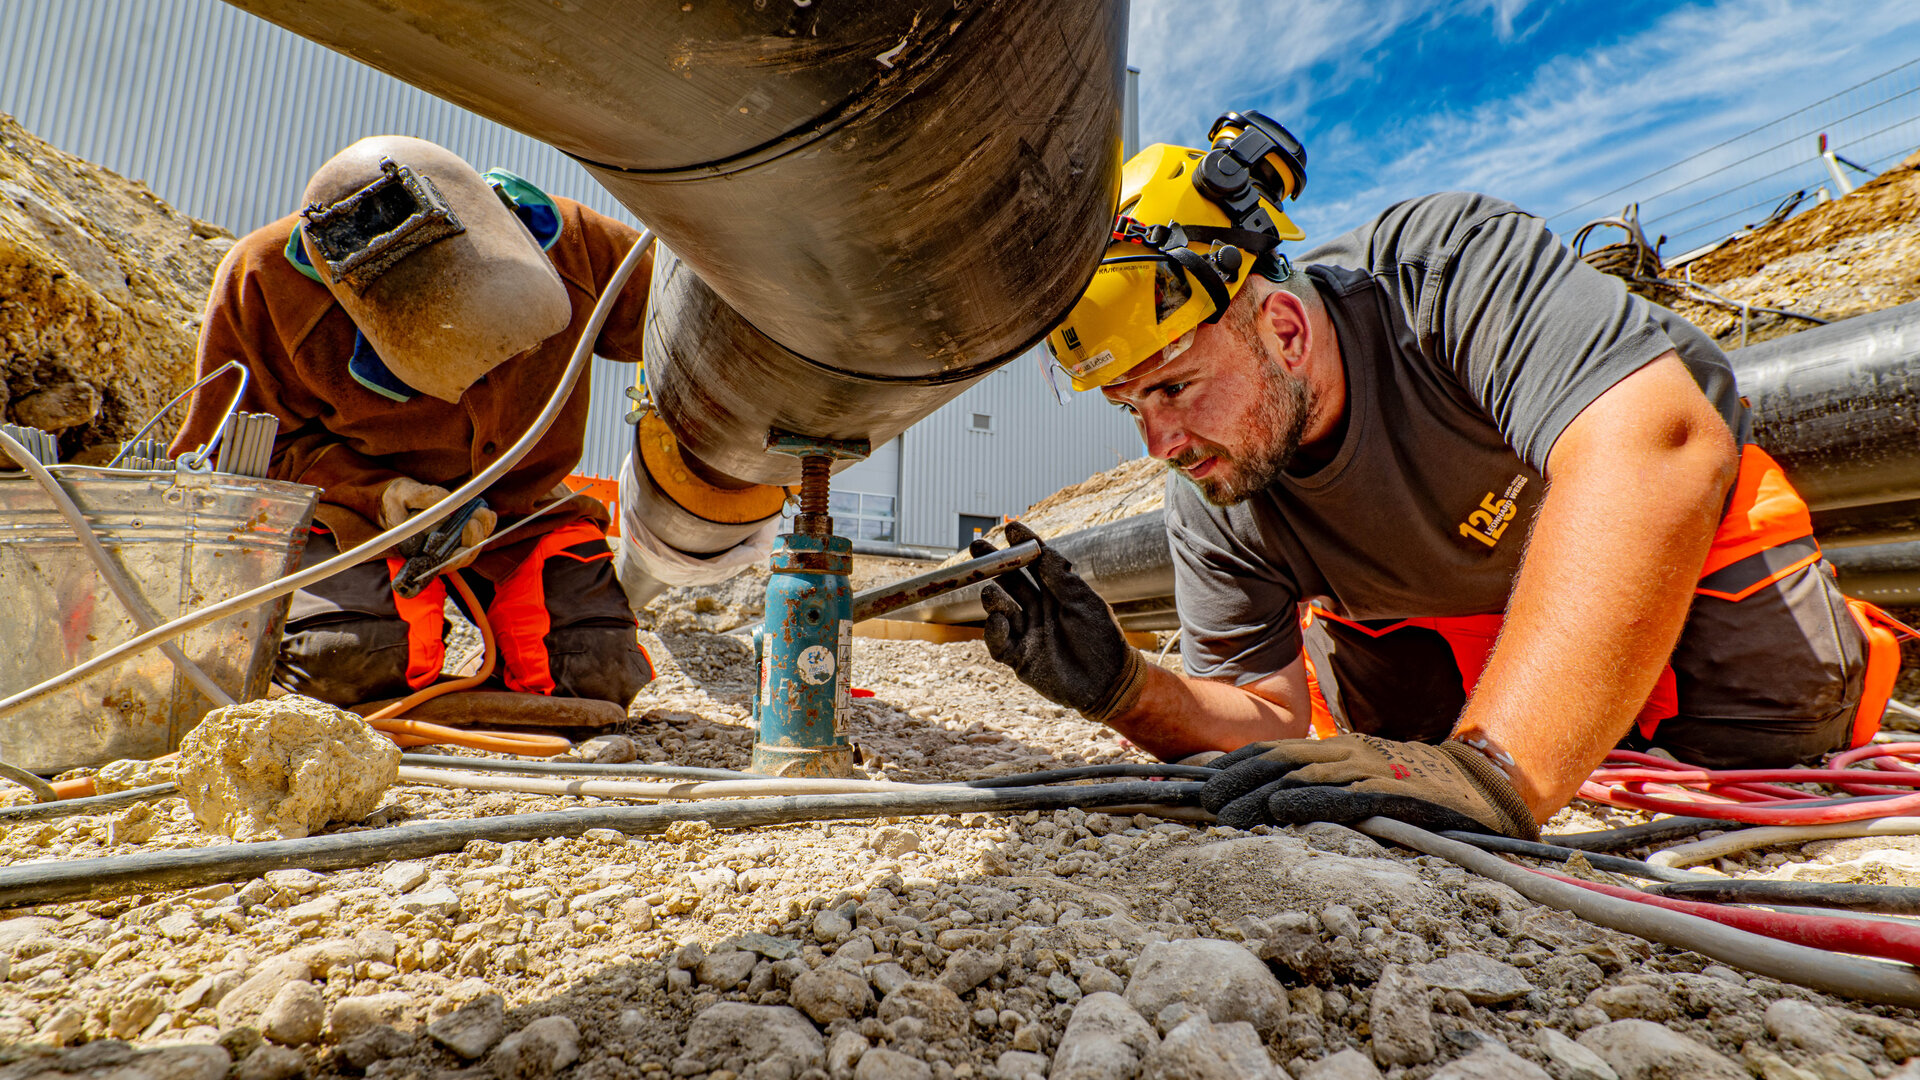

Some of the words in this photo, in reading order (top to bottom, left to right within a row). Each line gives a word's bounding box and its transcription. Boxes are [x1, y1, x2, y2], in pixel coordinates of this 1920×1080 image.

[1459, 491, 1517, 547] 125
[1484, 500, 1513, 536] LEONHARD
[1509, 476, 1528, 499] WEISS
